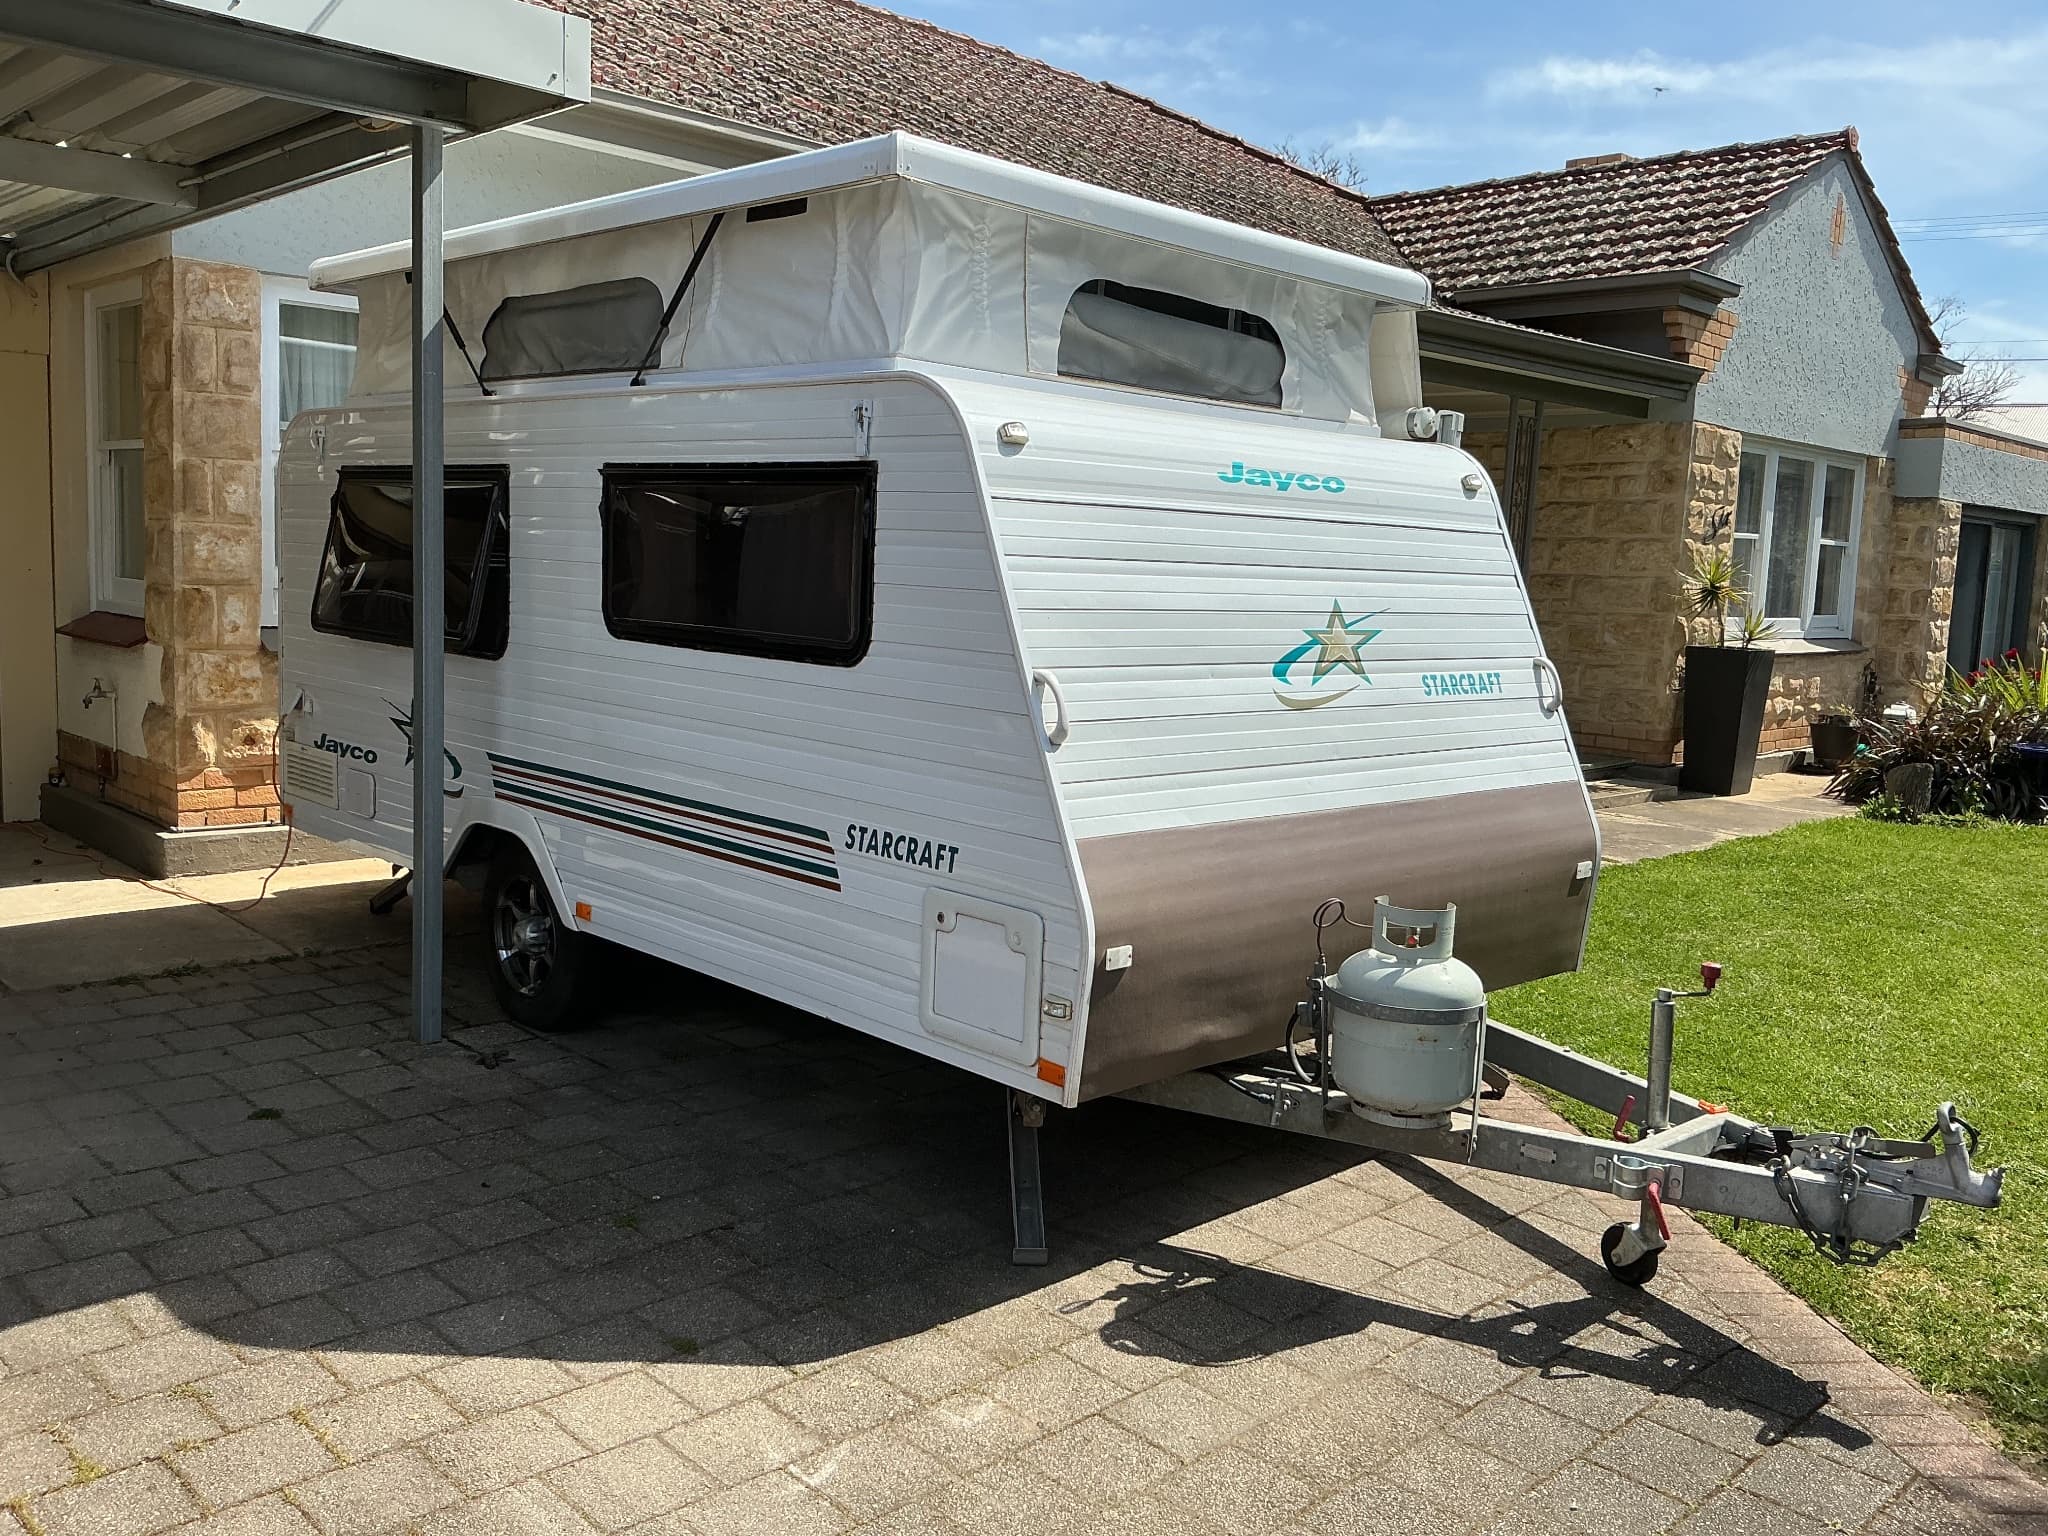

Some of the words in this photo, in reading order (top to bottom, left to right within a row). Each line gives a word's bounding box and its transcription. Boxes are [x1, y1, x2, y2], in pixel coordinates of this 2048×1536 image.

[1217, 461, 1345, 493] Jayco
[1421, 672, 1503, 697] STARCRAFT
[313, 732, 378, 764] Jayco
[845, 823, 960, 874] STARCRAFT
